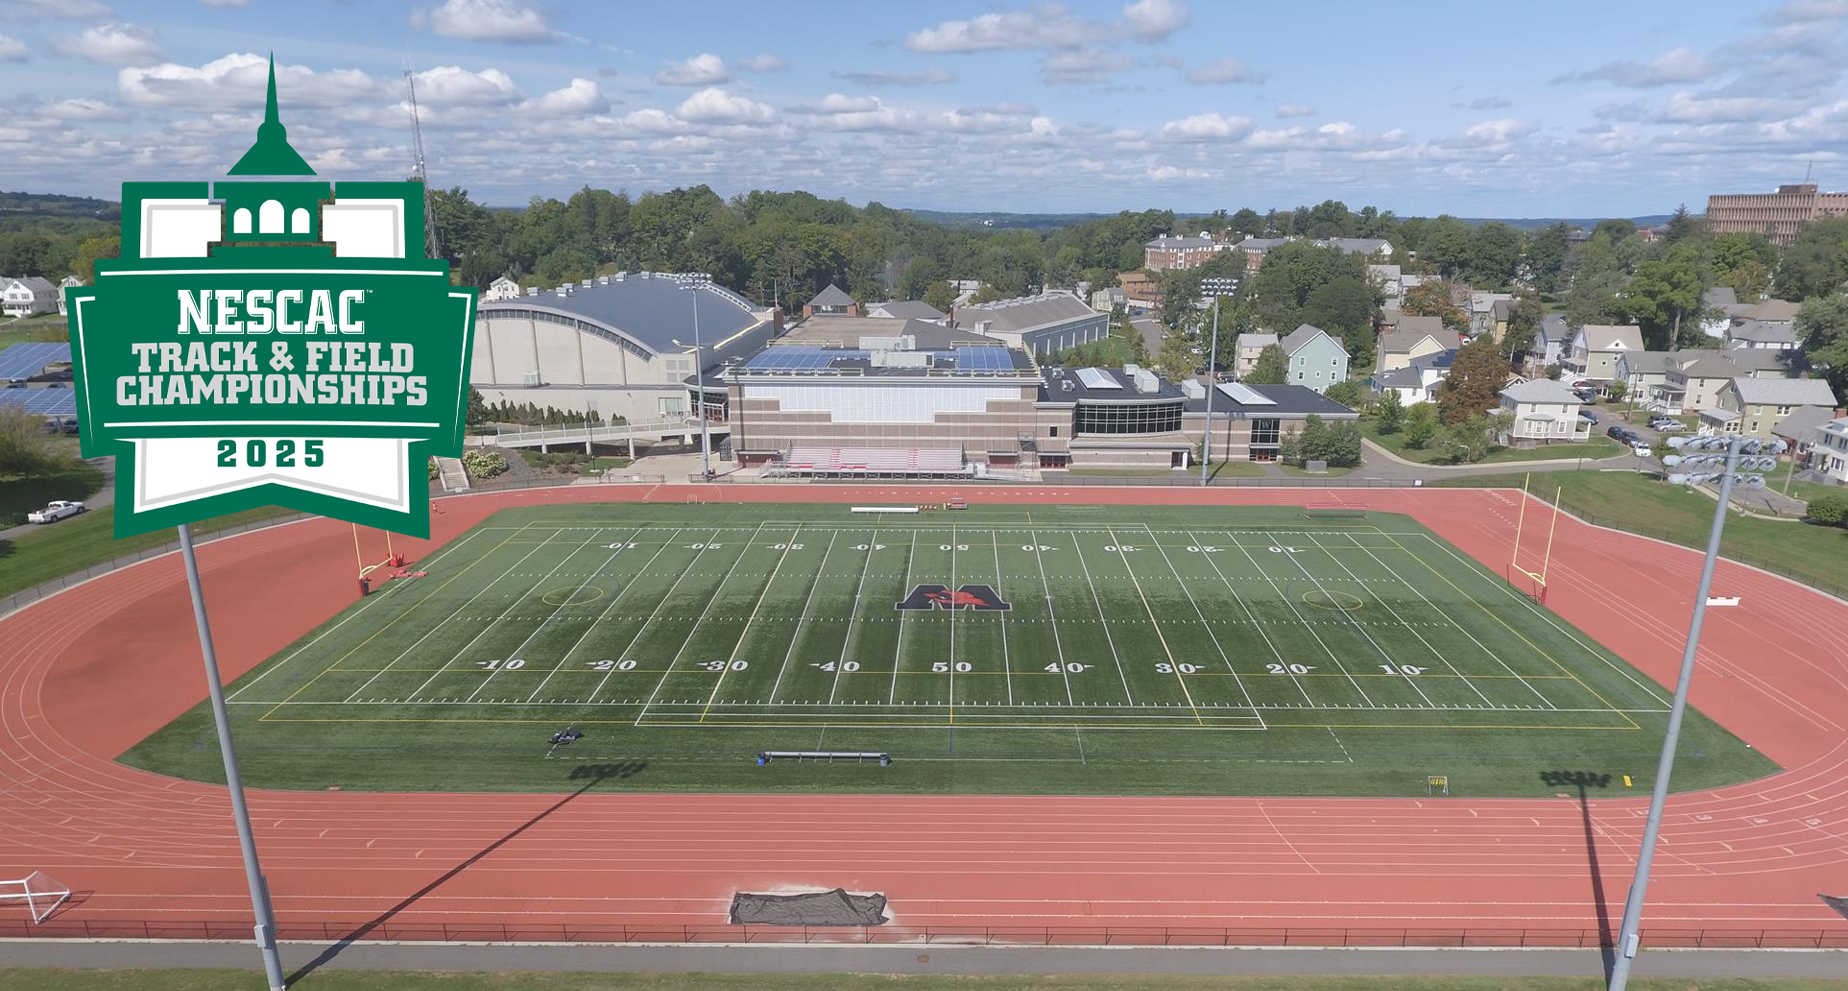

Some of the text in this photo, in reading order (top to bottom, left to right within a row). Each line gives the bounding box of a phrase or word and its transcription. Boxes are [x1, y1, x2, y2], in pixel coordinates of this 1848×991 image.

[482, 659, 525, 670] 10
[593, 660, 637, 670] 20
[706, 660, 749, 671] 30
[819, 661, 860, 672] 40
[931, 661, 972, 672] 50
[1044, 662, 1084, 673] 40
[1155, 663, 1196, 674] 30
[1265, 663, 1308, 674] 20
[1377, 664, 1421, 675] 10
